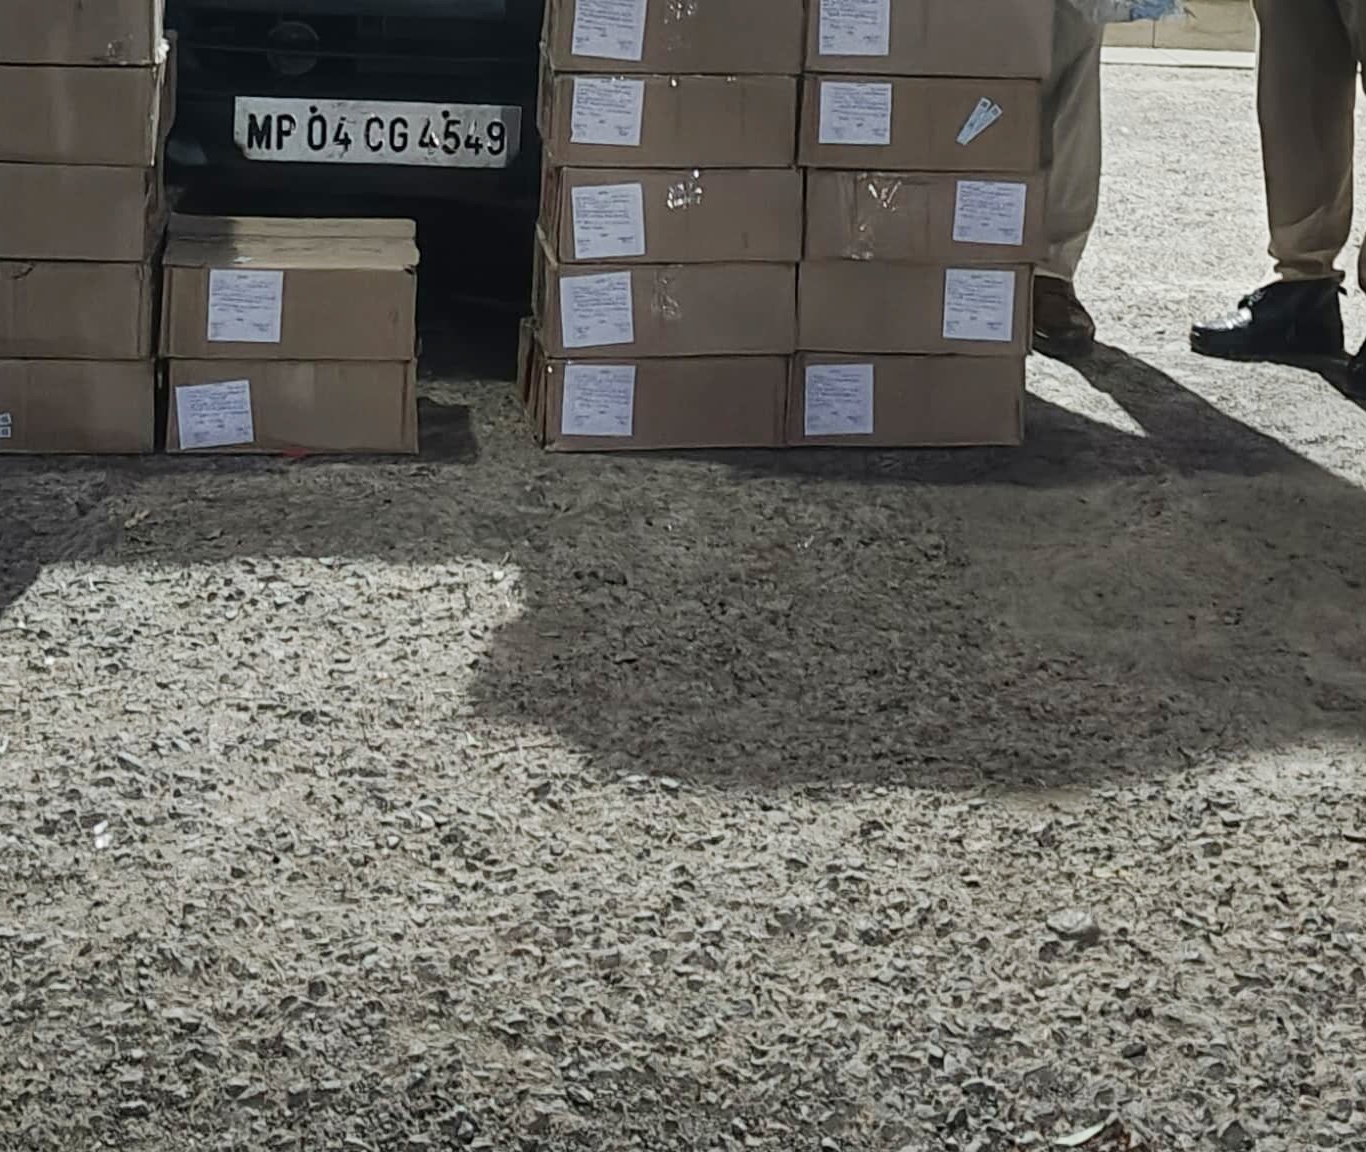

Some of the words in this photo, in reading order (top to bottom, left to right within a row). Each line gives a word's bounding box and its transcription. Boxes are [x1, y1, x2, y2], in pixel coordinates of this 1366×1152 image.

[247, 113, 297, 150] MP
[307, 114, 353, 152] 04
[364, 116, 409, 152] CG
[418, 117, 507, 155] 4549
